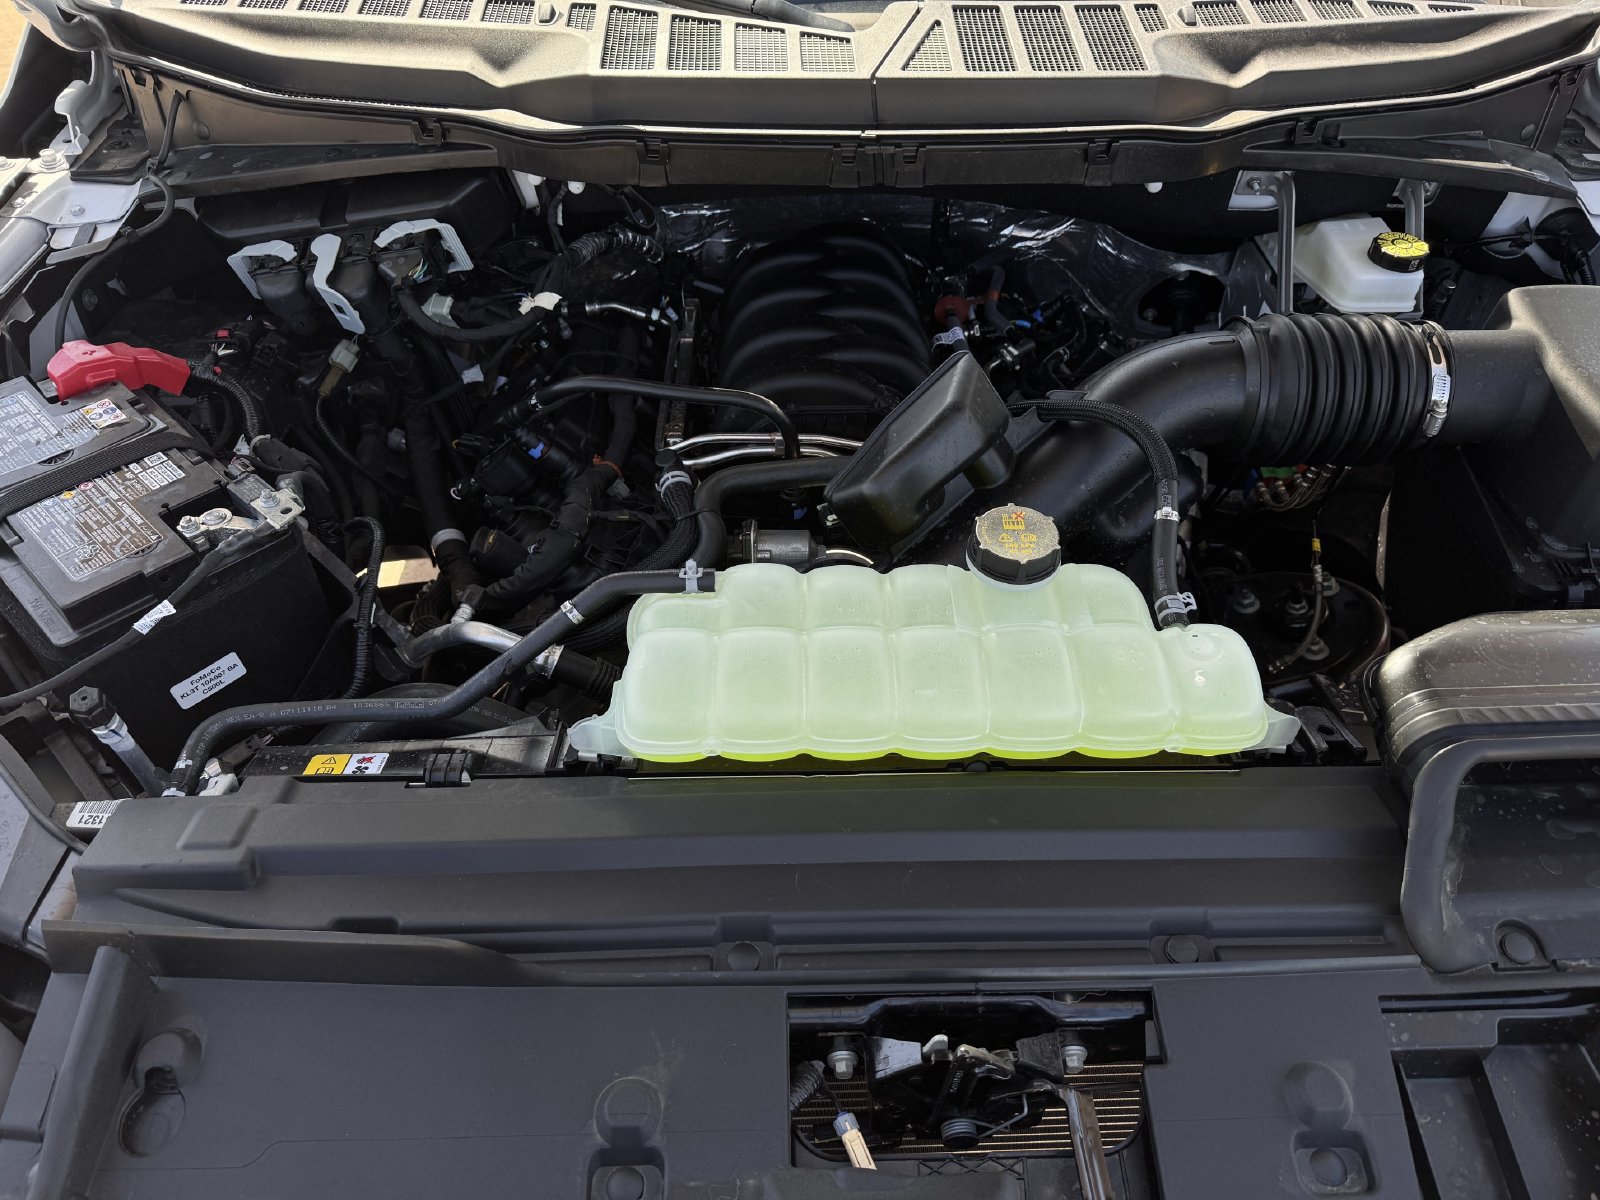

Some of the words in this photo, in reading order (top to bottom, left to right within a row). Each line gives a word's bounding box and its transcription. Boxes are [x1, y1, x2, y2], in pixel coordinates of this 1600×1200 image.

[180, 685, 200, 700] KL3T
[227, 663, 239, 672] BA
[190, 665, 221, 686] FoMoCo
[202, 680, 225, 695] C500L
[78, 814, 110, 826] 1321
